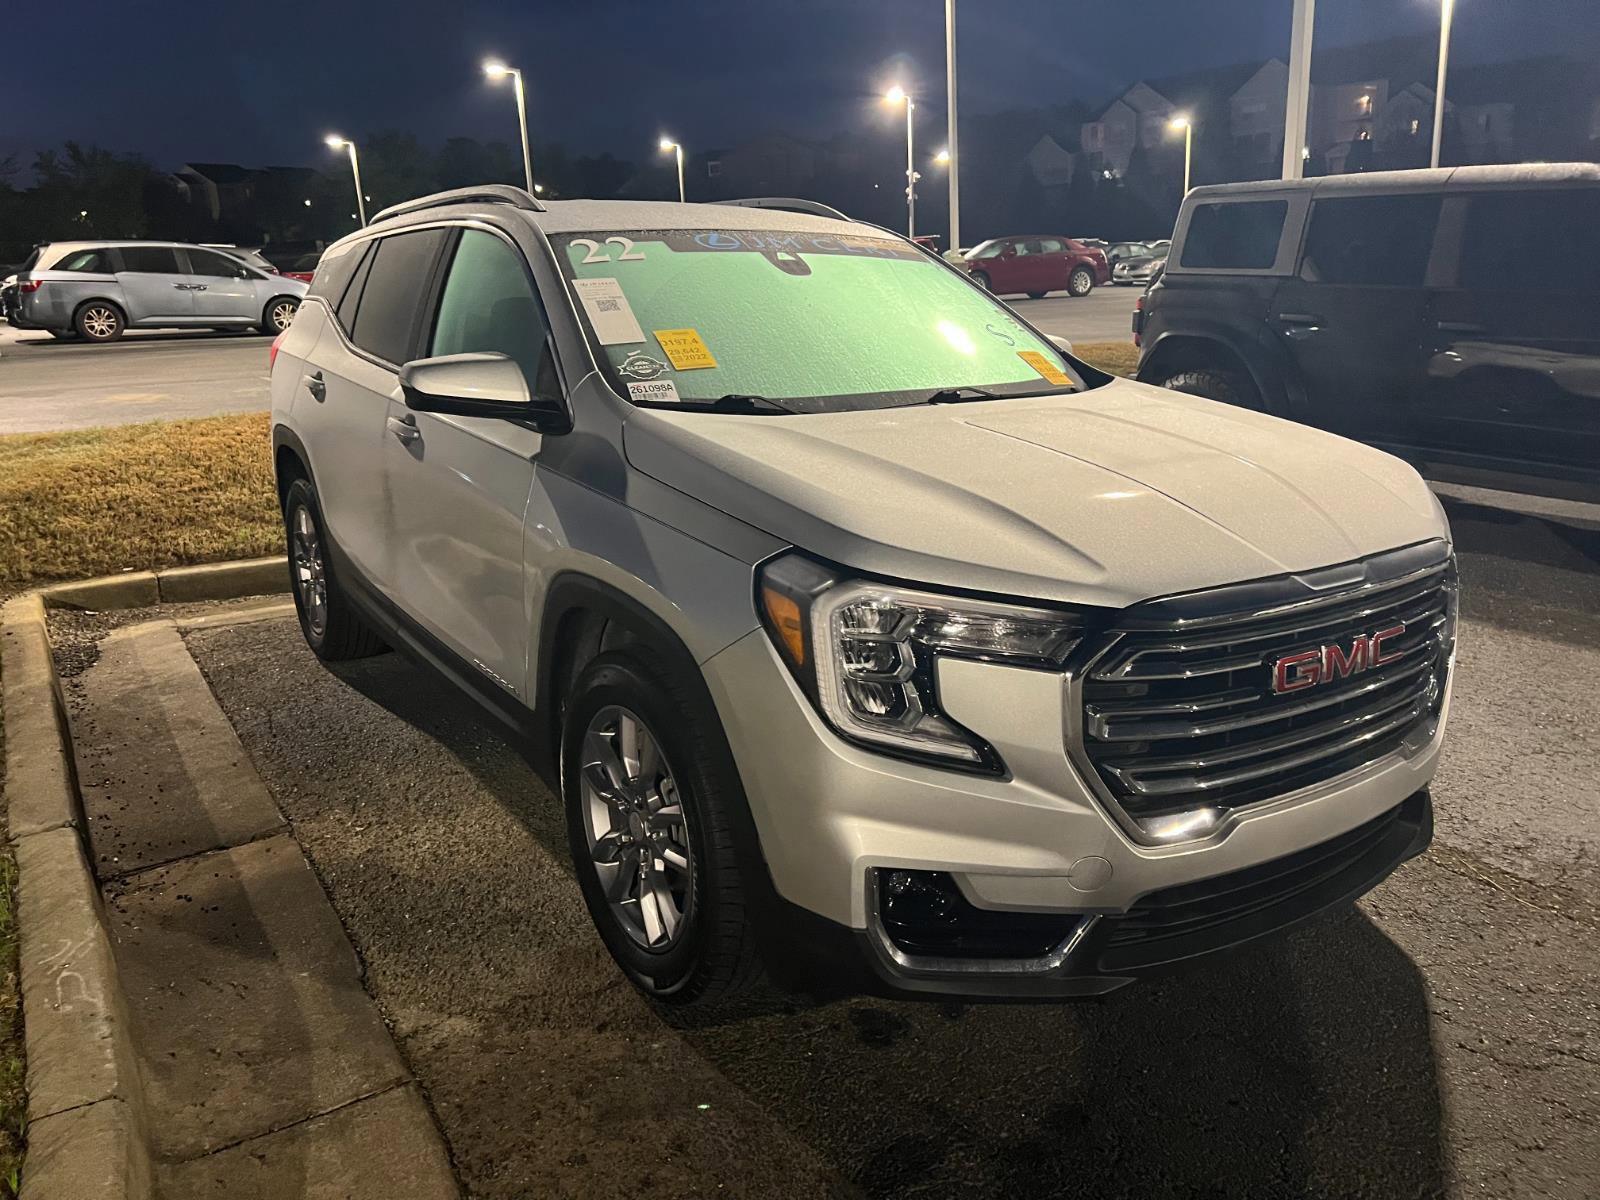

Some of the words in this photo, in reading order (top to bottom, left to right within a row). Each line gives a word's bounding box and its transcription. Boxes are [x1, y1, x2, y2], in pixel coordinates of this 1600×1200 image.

[570, 236, 645, 263] 22
[630, 384, 673, 394] 261098A
[1272, 624, 1406, 695] GMC
